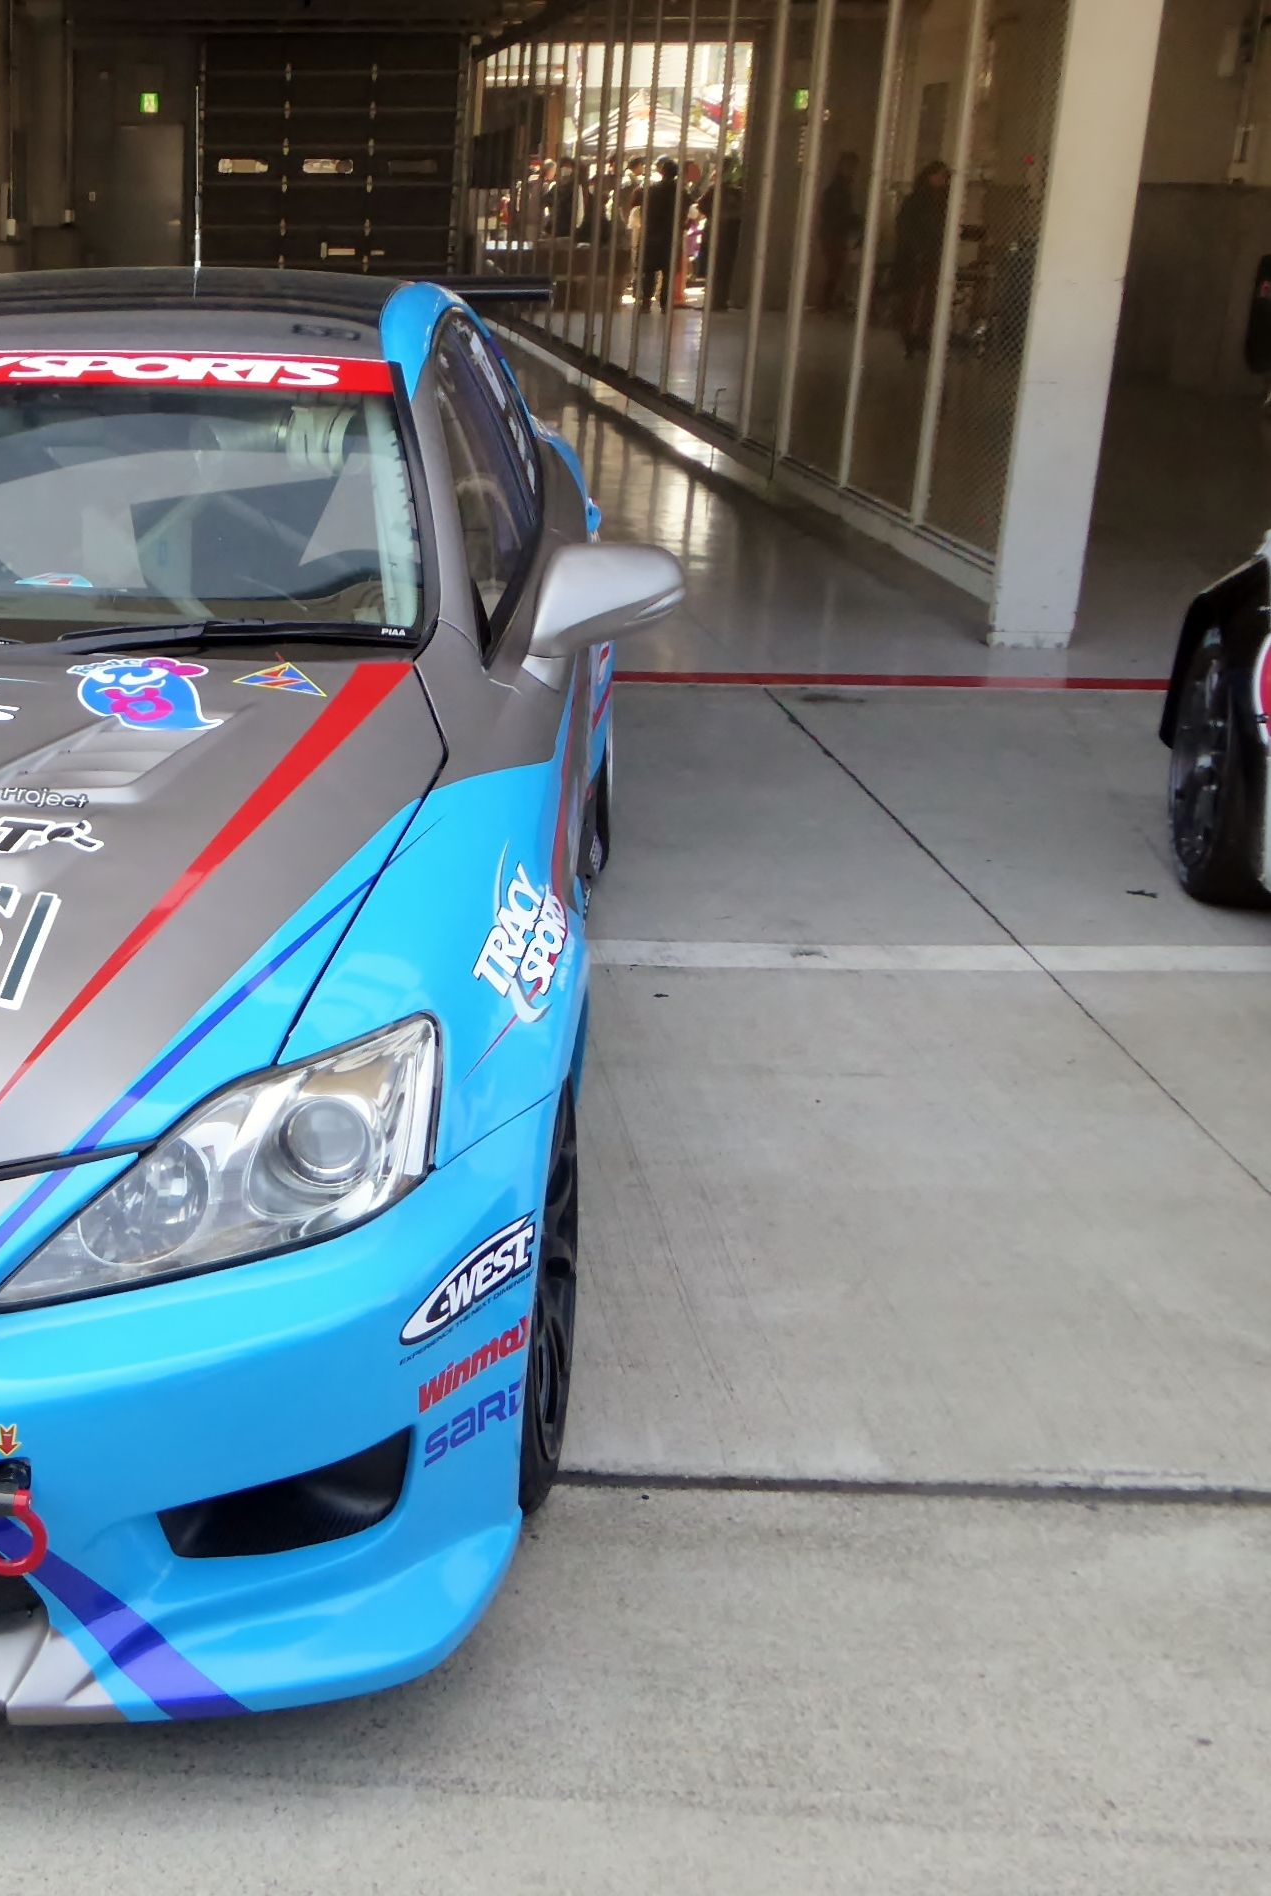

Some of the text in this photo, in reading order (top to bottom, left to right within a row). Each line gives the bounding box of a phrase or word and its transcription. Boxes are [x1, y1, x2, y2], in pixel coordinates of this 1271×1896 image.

[381, 627, 406, 637] PIAA
[2, 787, 90, 810] Project
[472, 861, 546, 998] TRACY
[519, 883, 567, 996] SPOR
